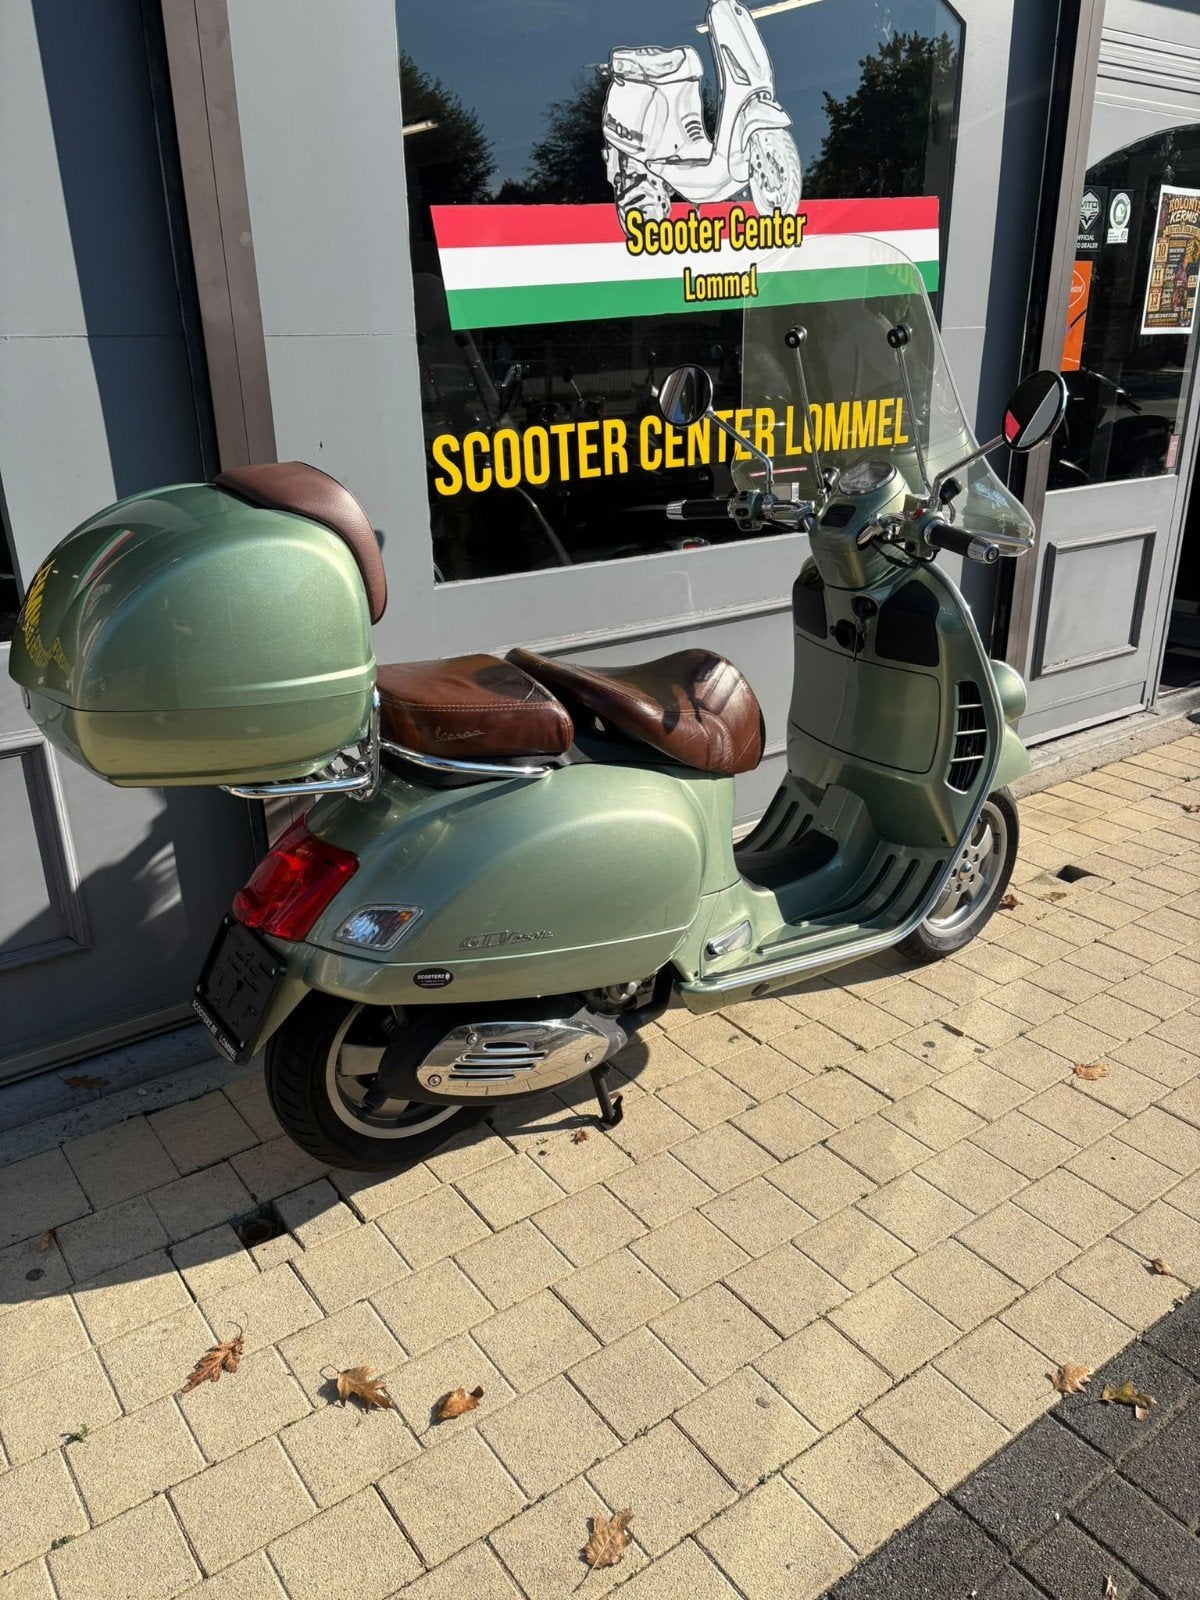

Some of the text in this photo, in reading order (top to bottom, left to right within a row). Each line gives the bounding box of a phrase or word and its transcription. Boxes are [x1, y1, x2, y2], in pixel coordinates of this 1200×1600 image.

[626, 206, 807, 256] Scooter Center
[1170, 210, 1199, 224] KERMIS
[683, 263, 758, 302] Lommel
[432, 398, 908, 496] SCOOTER CENTER LOMMEL
[219, 1035, 237, 1061] LOMMEL
